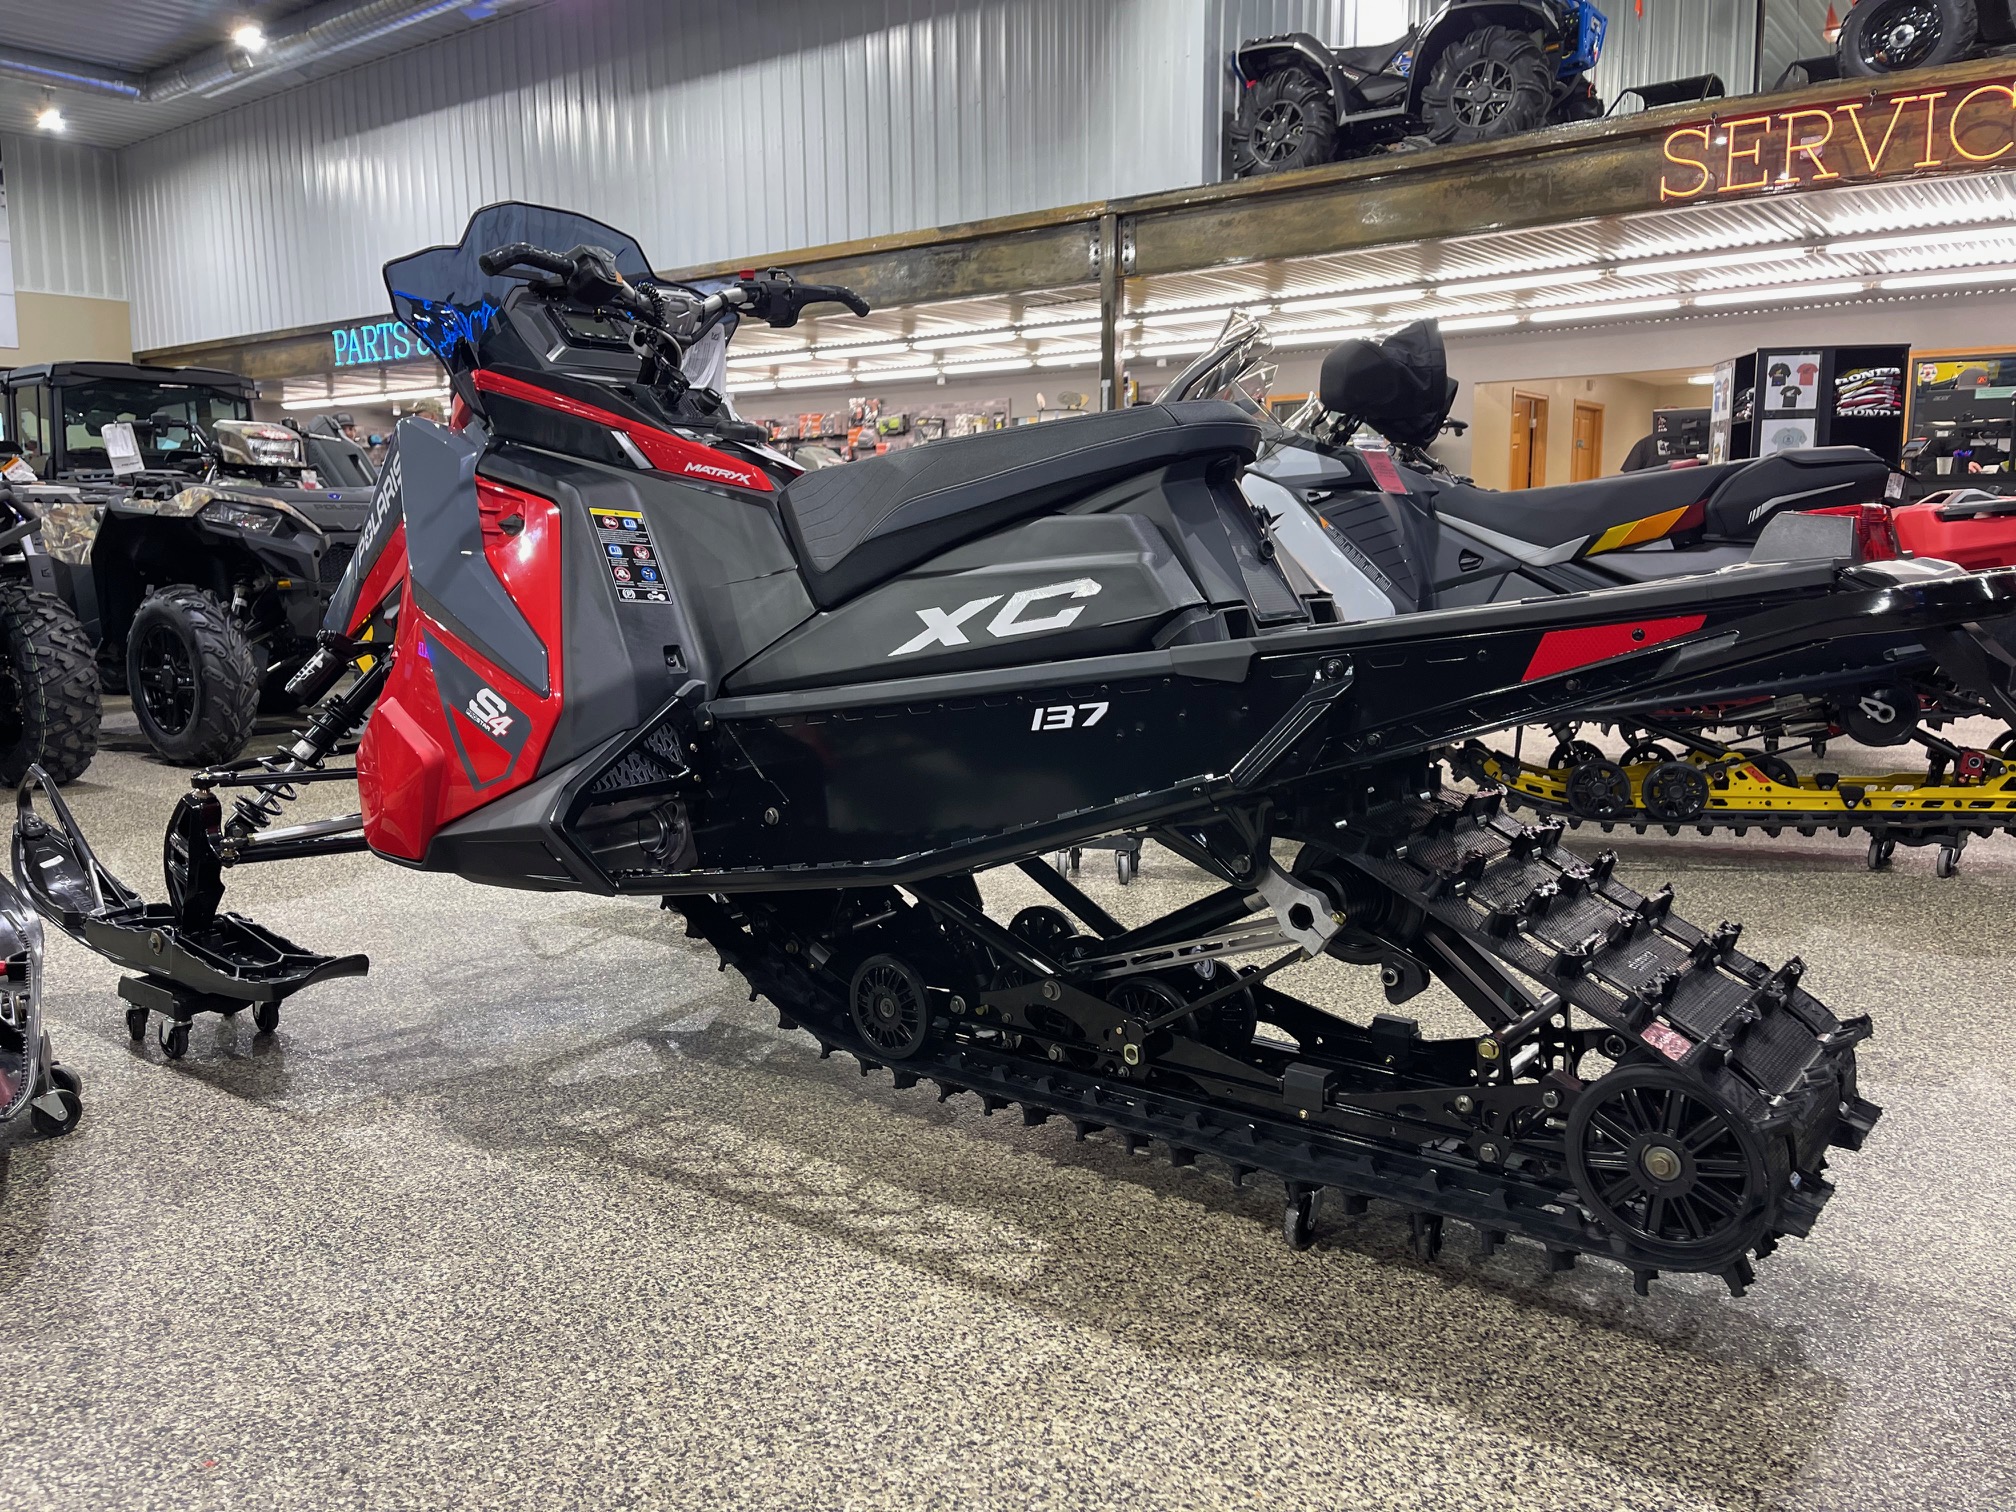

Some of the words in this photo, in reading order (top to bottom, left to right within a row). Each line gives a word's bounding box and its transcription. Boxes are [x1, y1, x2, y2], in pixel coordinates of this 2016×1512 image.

[331, 321, 411, 367] PARTS
[1932, 394, 1951, 402] acer
[683, 461, 752, 486] MATRYX
[887, 576, 1103, 657] XC
[468, 687, 515, 738] S4
[1030, 701, 1110, 732] 137
